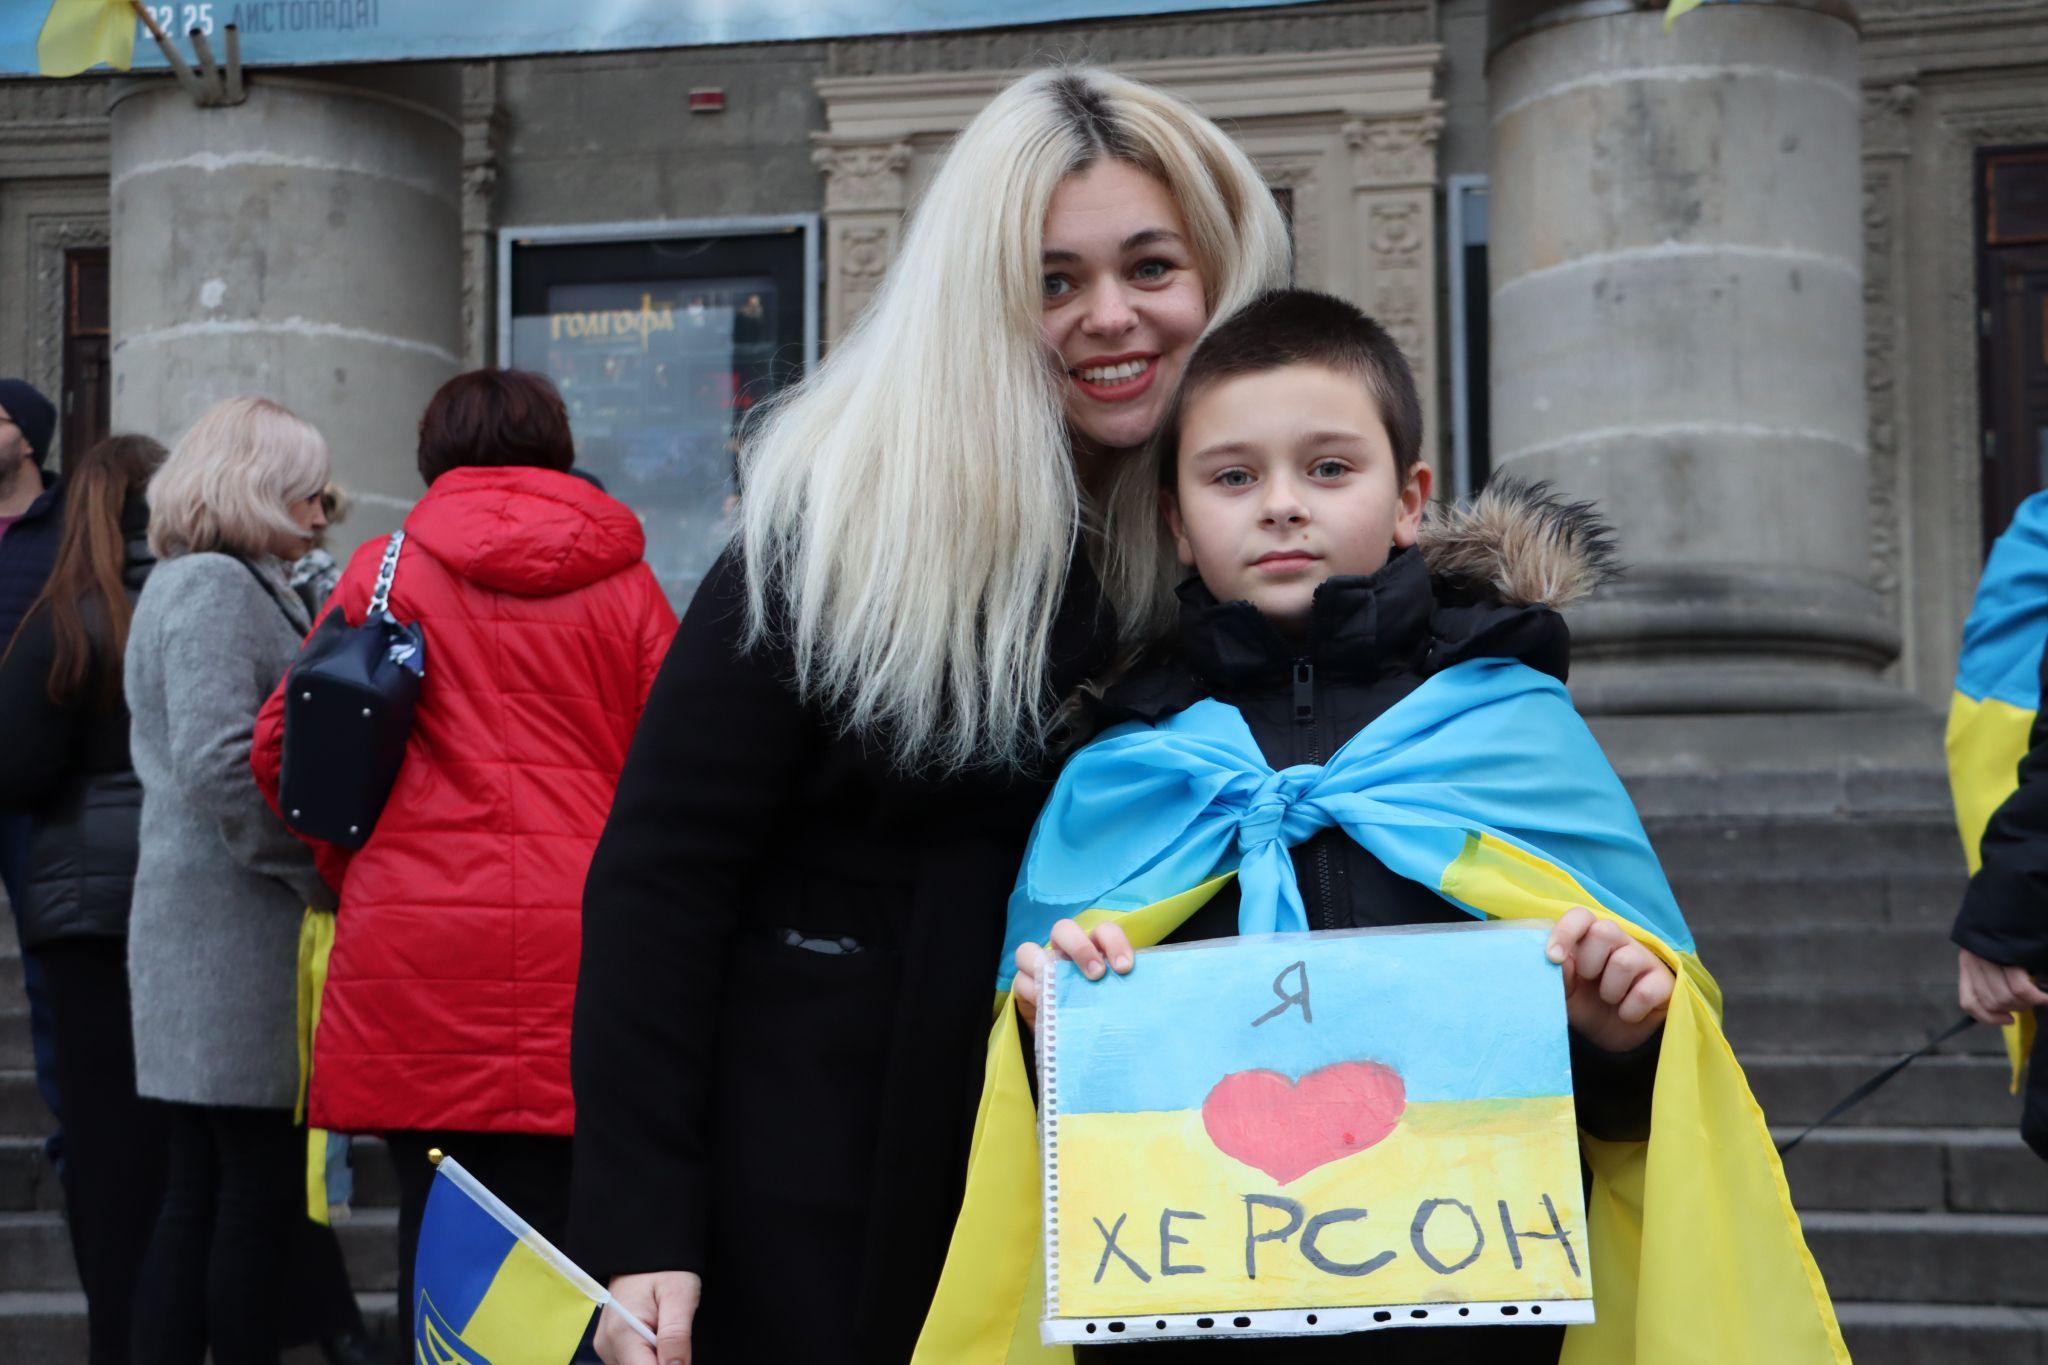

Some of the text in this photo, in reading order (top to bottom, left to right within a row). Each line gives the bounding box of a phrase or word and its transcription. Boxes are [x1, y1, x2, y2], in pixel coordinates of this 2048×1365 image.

[184, 3, 213, 37] 25
[1251, 960, 1312, 1027] Я
[1093, 1193, 1581, 1284] ХЕРСОН
